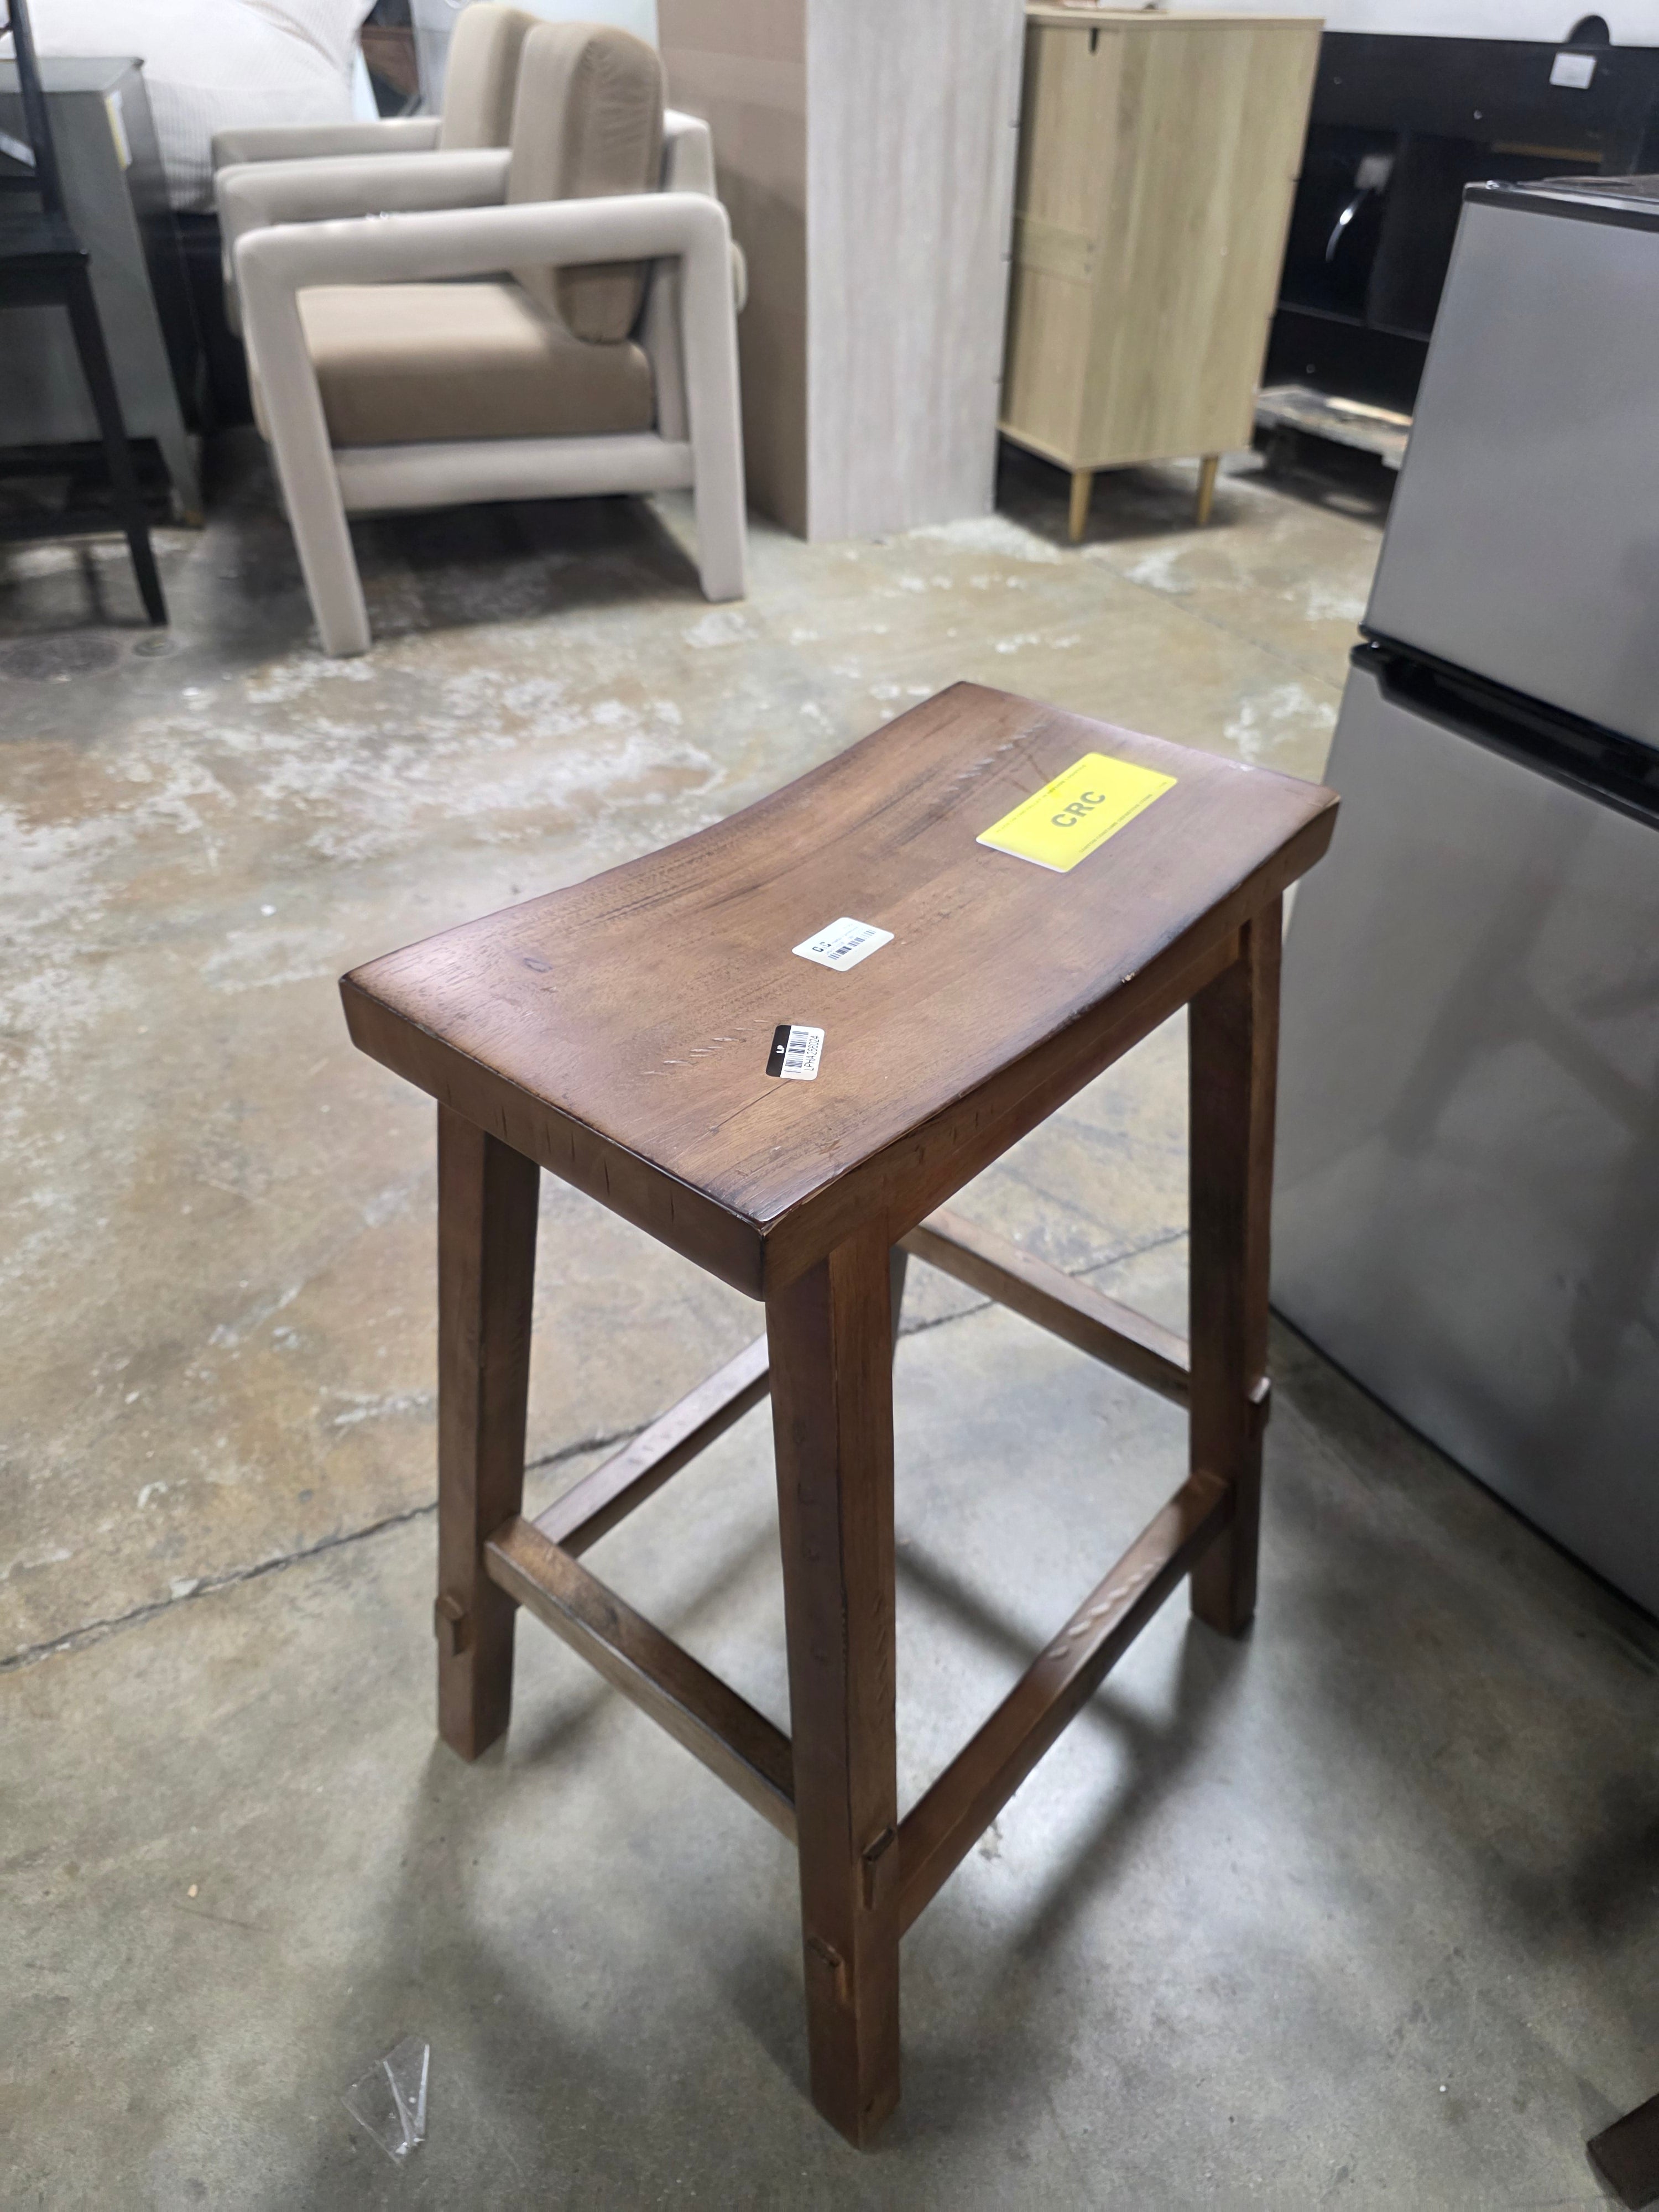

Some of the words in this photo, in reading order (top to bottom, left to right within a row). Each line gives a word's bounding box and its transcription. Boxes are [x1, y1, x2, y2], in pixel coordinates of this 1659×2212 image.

[1051, 791, 1105, 828] CRC
[812, 942, 831, 952] CC
[776, 1045, 785, 1053] LP
[804, 1036, 820, 1071] LPHA266024
